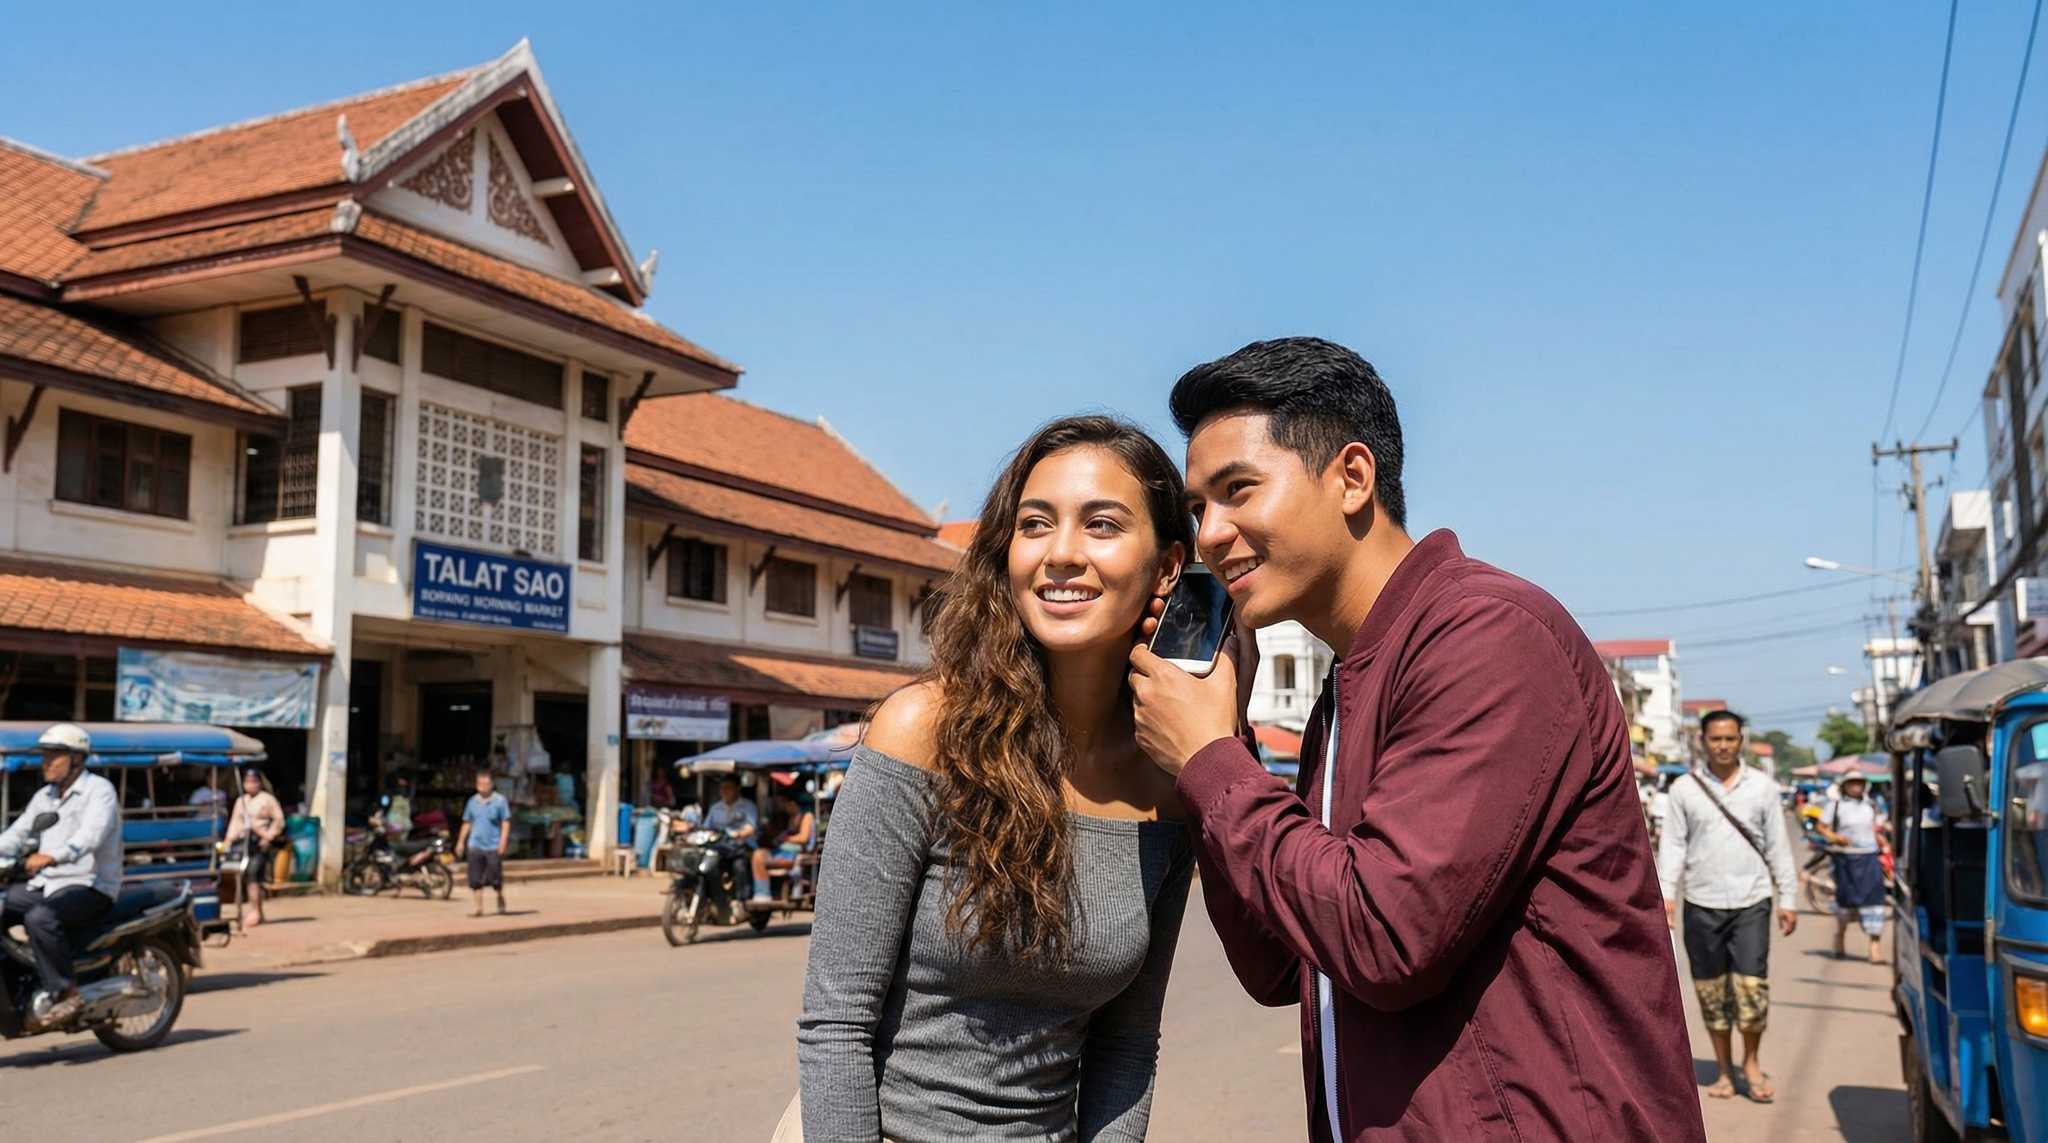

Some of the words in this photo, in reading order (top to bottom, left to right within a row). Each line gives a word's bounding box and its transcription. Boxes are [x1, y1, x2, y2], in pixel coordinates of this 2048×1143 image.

[423, 552, 508, 591] TALAT
[514, 567, 564, 599] SAO
[525, 603, 564, 618] MARKET
